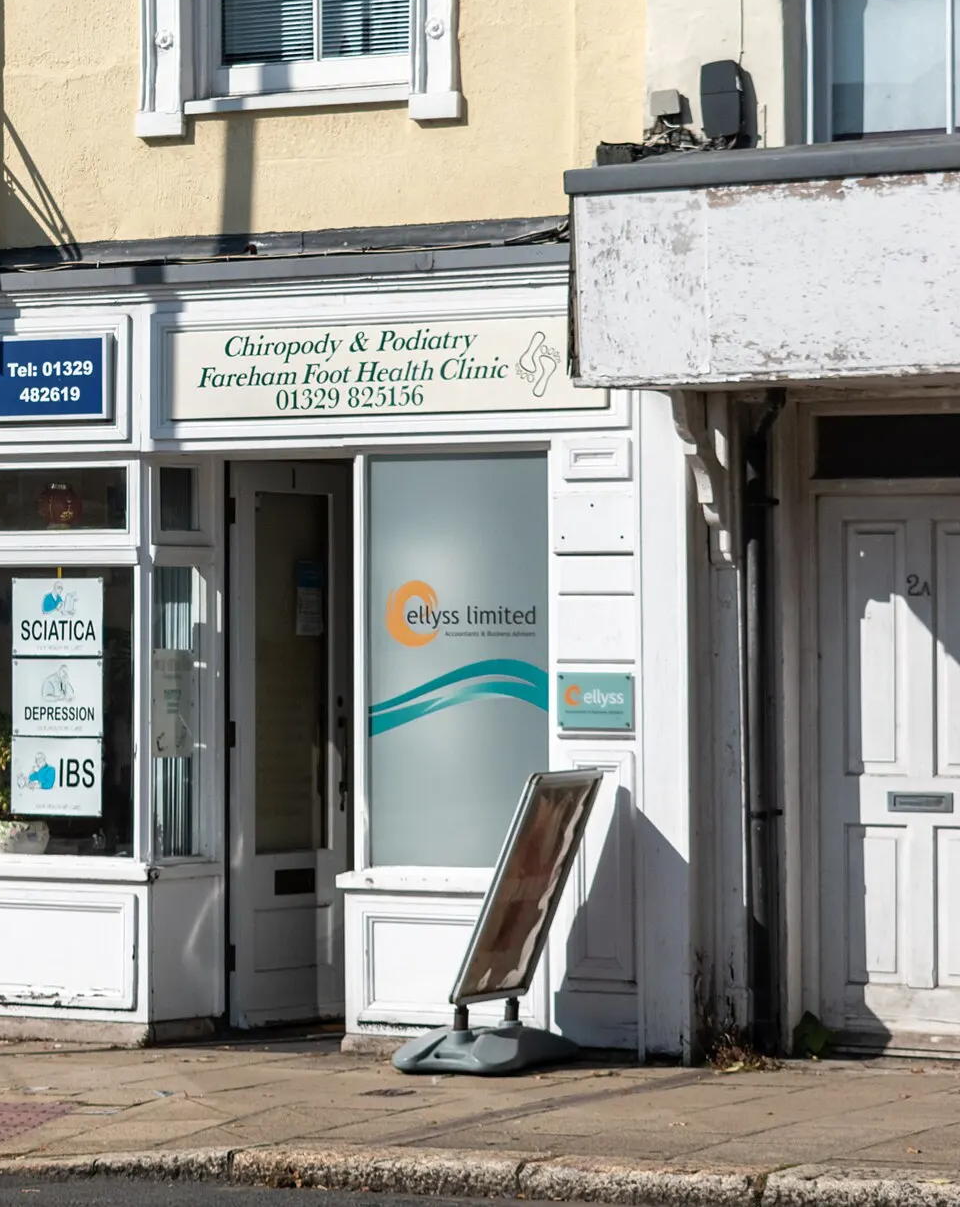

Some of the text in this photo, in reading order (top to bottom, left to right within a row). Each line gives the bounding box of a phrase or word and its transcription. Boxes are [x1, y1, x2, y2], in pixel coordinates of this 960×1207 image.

[224, 328, 478, 367] Chiropody & Podiatry
[7, 360, 93, 378] Tel: 01329
[197, 357, 509, 389] Fareham Foot Health Clinic
[19, 386, 81, 403] 482619
[276, 384, 424, 411] 01329 825156
[407, 605, 537, 629] ellyss limited
[20, 619, 96, 642] SCIATICA
[583, 689, 624, 708] ellyss
[24, 706, 95, 722] DEPRESSION
[58, 757, 95, 789] IBS
